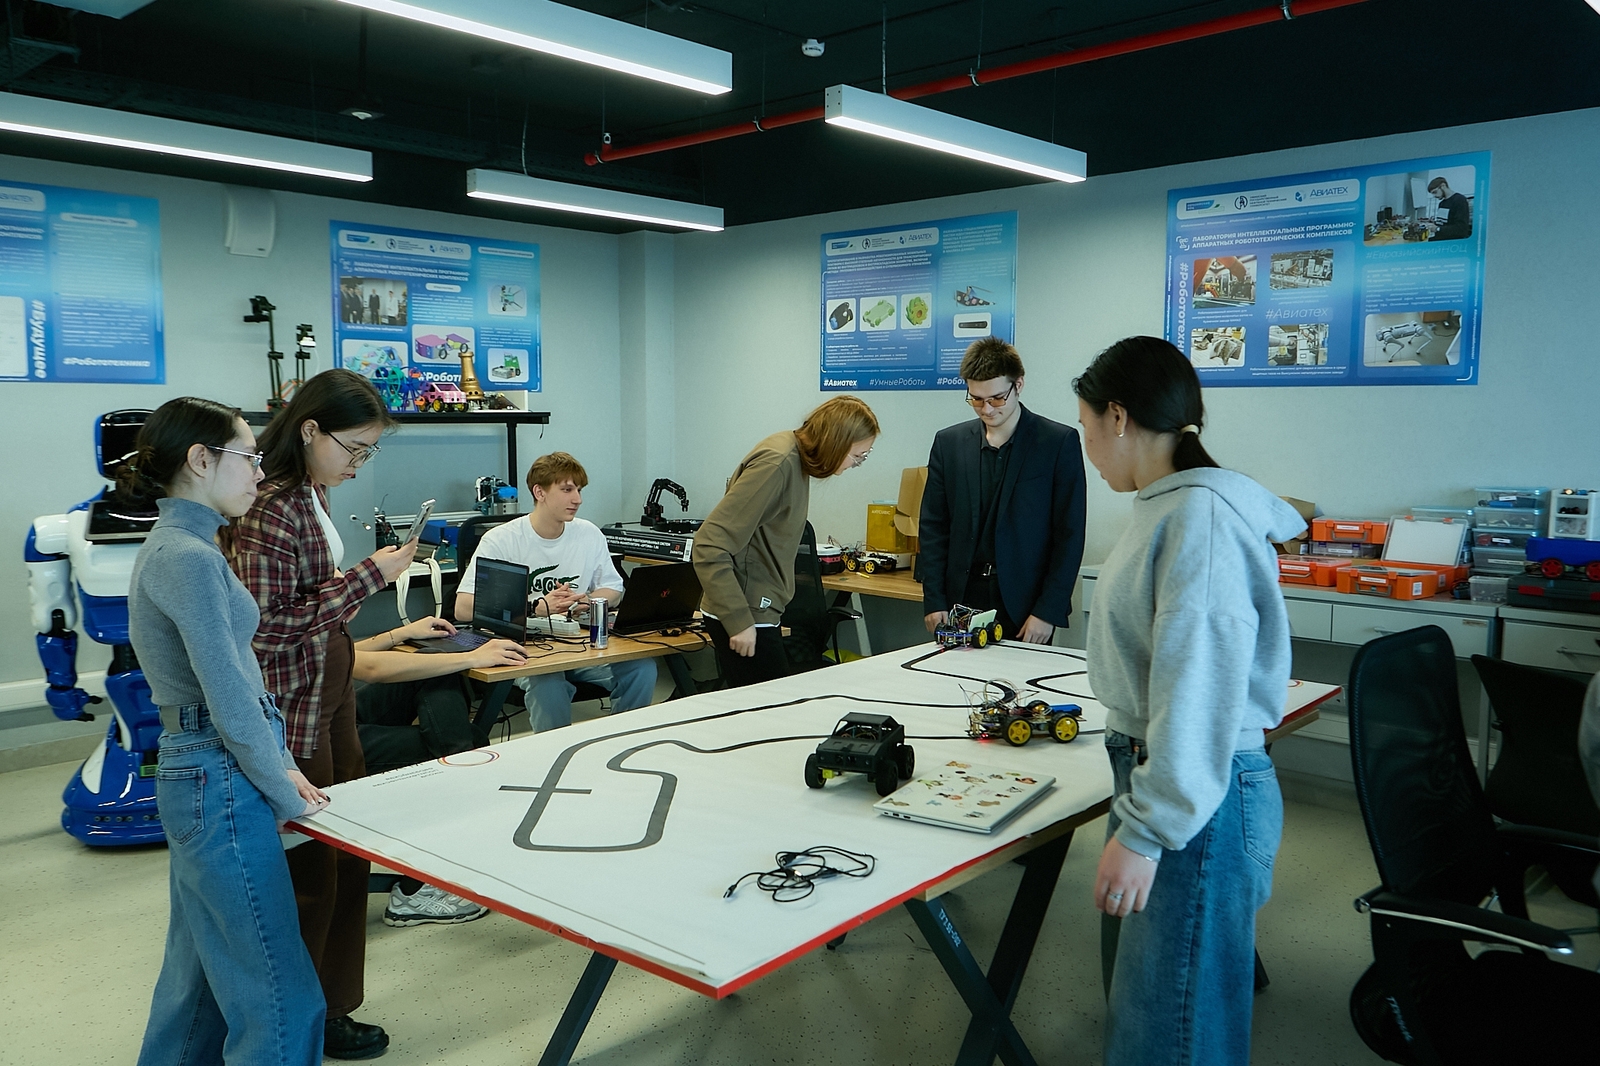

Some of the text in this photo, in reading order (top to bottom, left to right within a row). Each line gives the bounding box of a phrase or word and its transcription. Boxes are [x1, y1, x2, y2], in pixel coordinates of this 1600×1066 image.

[1310, 187, 1348, 197] АВИАТЕХ
[908, 233, 933, 241] АВИАТЕХ
[1192, 222, 1356, 242] ЛАБОРАТОРИЯ ИНТЕЛЛЕКТУАЛЬНЫХ ПРОГРАММНО-
[1192, 229, 1353, 249] АППАРАТНЫХ РОБОТОТЕХНИЧЕСКИХ КОМПЛЕКСОВ
[1366, 244, 1468, 259] #ЕвразийскийНОЦ
[1177, 263, 1189, 352] #Робототехн
[1265, 308, 1328, 319] #Авиатех
[29, 299, 47, 379] #Будущее
[824, 377, 966, 387] #Авиатех #УмныеРоботы #Робот
